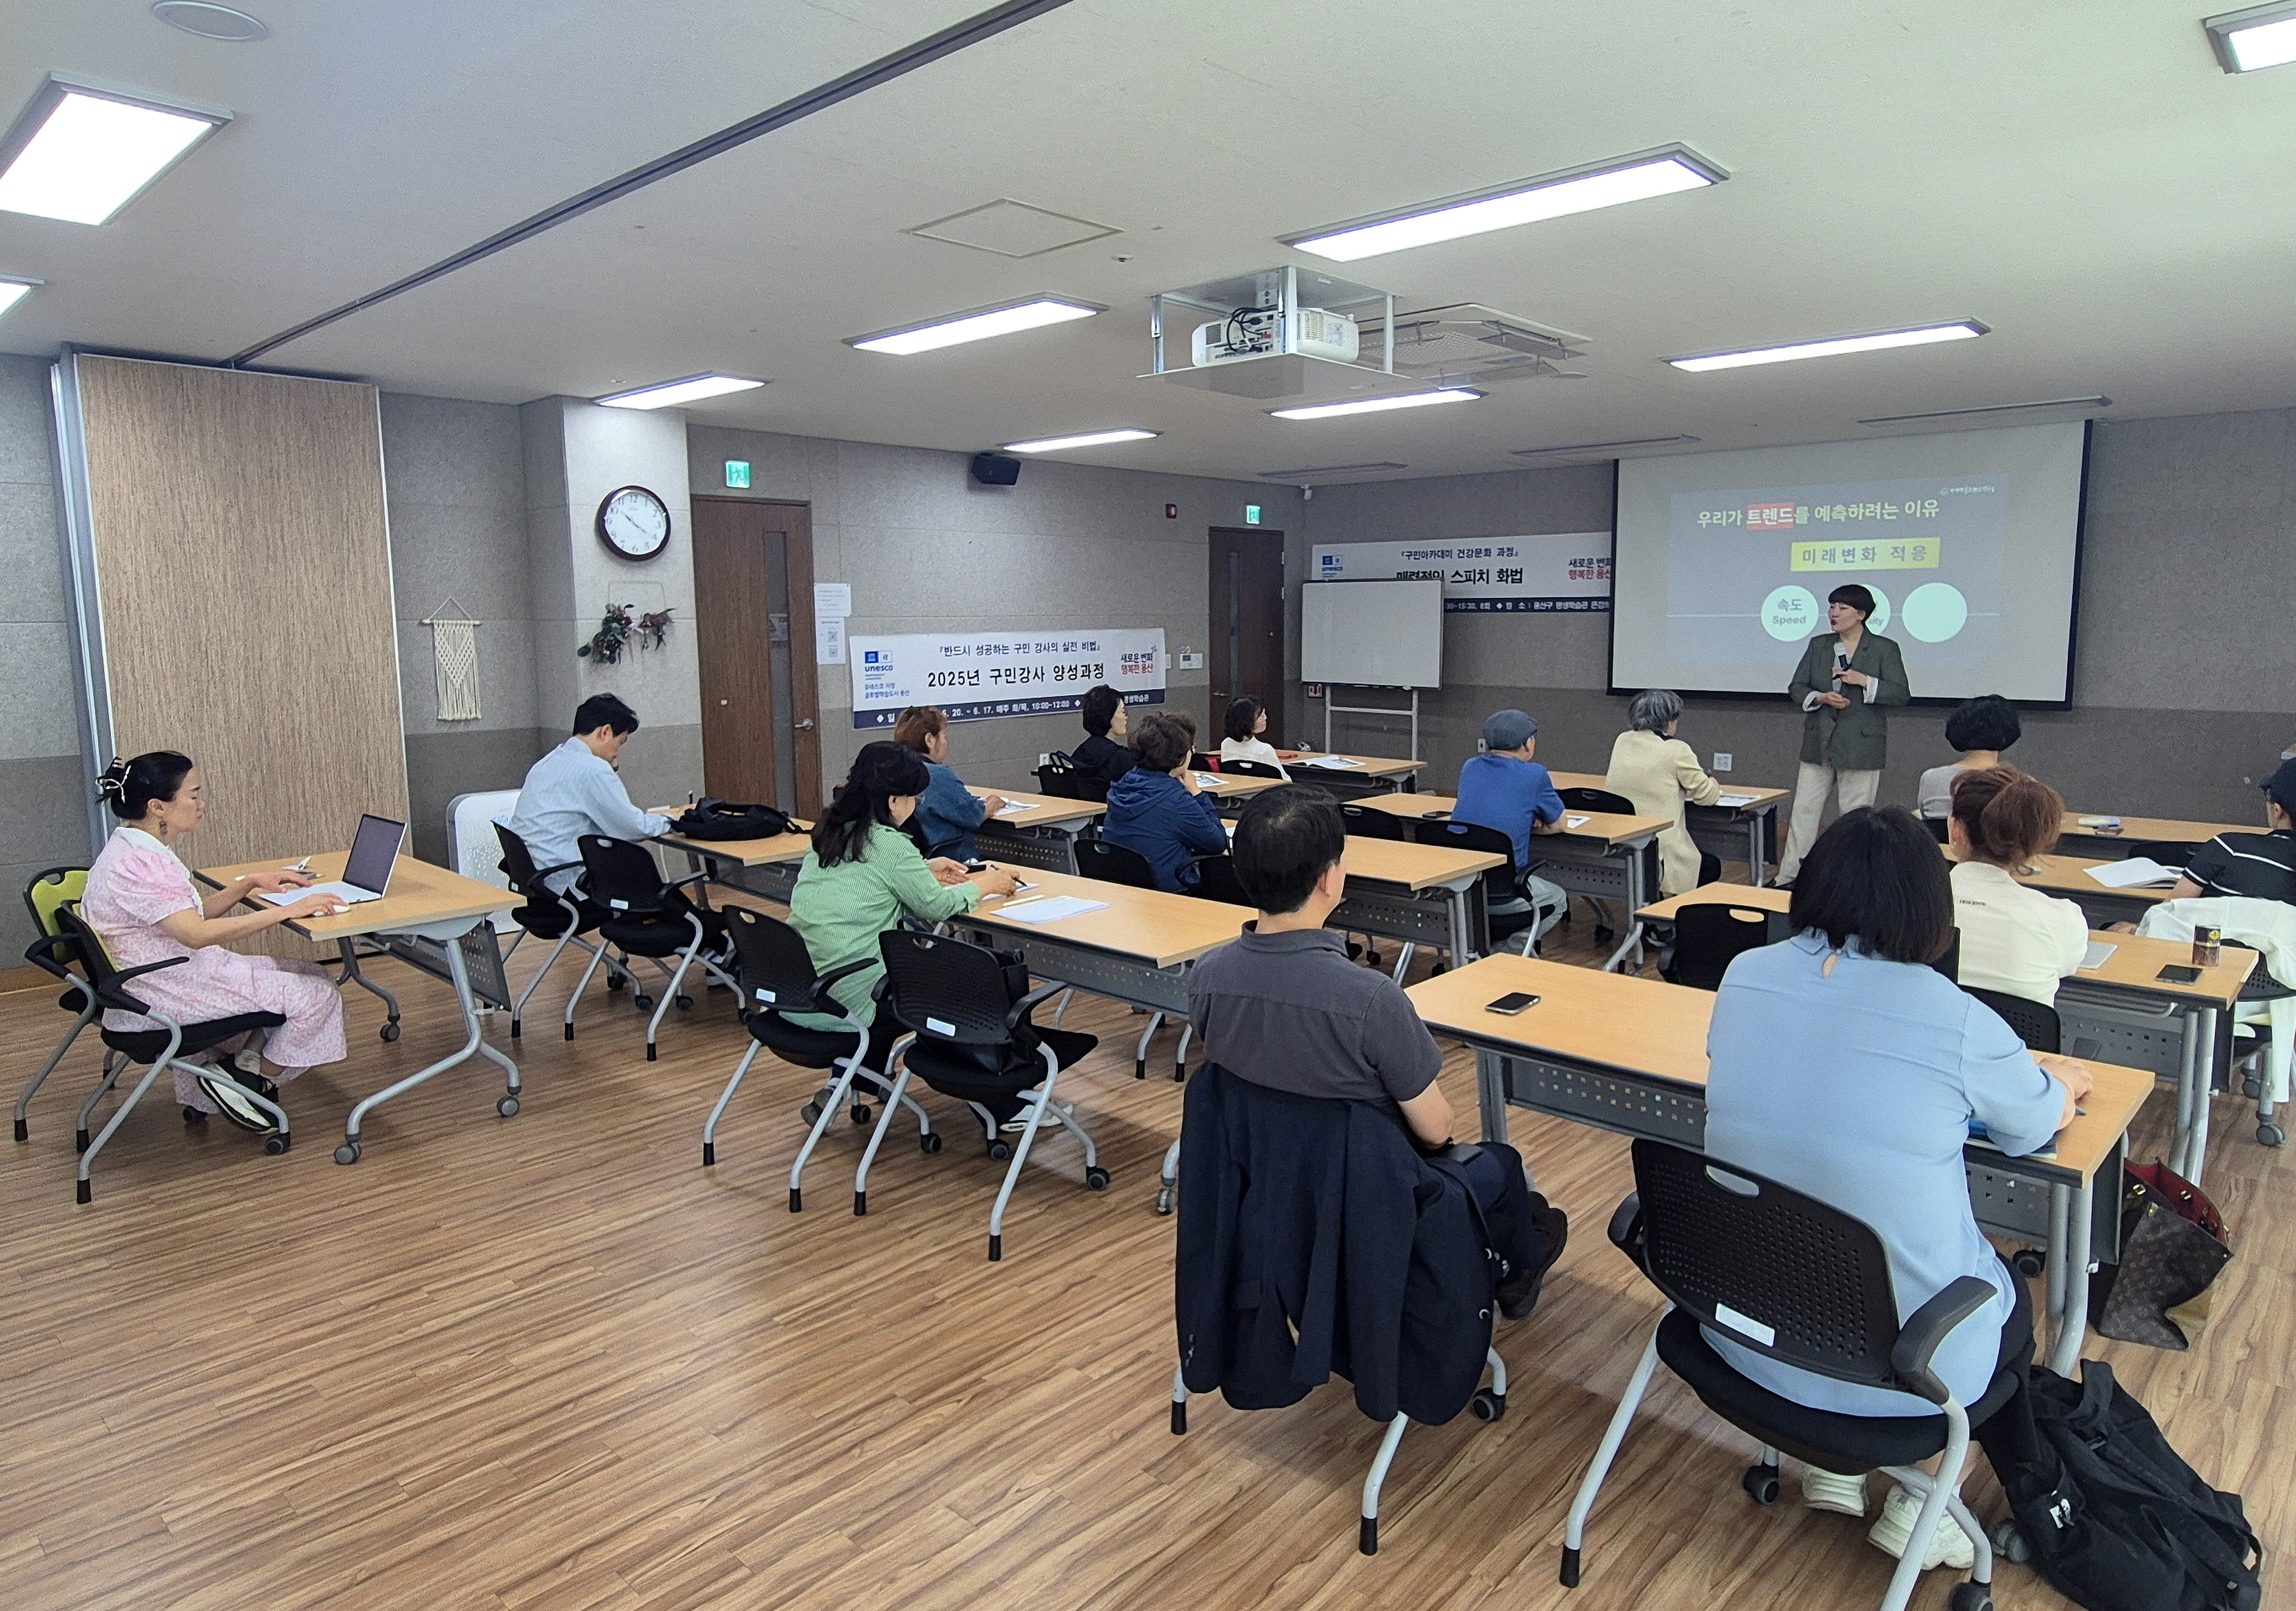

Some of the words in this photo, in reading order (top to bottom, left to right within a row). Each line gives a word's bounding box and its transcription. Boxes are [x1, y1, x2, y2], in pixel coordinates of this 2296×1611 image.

[1697, 510, 1743, 528] 우리가
[1746, 506, 1809, 525] 트렌드를
[1814, 502, 1899, 522] 예측하려는
[1904, 500, 1939, 518] 이유
[1457, 548, 1492, 559] 건강문화
[1802, 547, 1876, 564] 미래변화
[1891, 545, 1927, 562] 적용
[1568, 558, 1595, 569] 새로운
[1451, 569, 1490, 585] 스피치
[1496, 567, 1523, 584] 화법
[1568, 569, 1594, 580] 행복한
[1777, 598, 1803, 611] 속도
[1772, 615, 1806, 626] Speed
[976, 644, 1010, 656] 성공하는
[1014, 642, 1030, 654] 구민
[1035, 642, 1058, 653] 강사의
[1062, 641, 1077, 652] 실전
[1121, 653, 1139, 663] 새로운
[1140, 653, 1153, 663] 변화
[928, 669, 980, 687] 2025년
[989, 666, 1045, 685] 구민강사
[1053, 662, 1104, 681] 양성과정
[1122, 664, 1140, 675] 행복한
[1141, 663, 1153, 673] 용산
[952, 708, 964, 717] 20.
[983, 706, 994, 714] 17.
